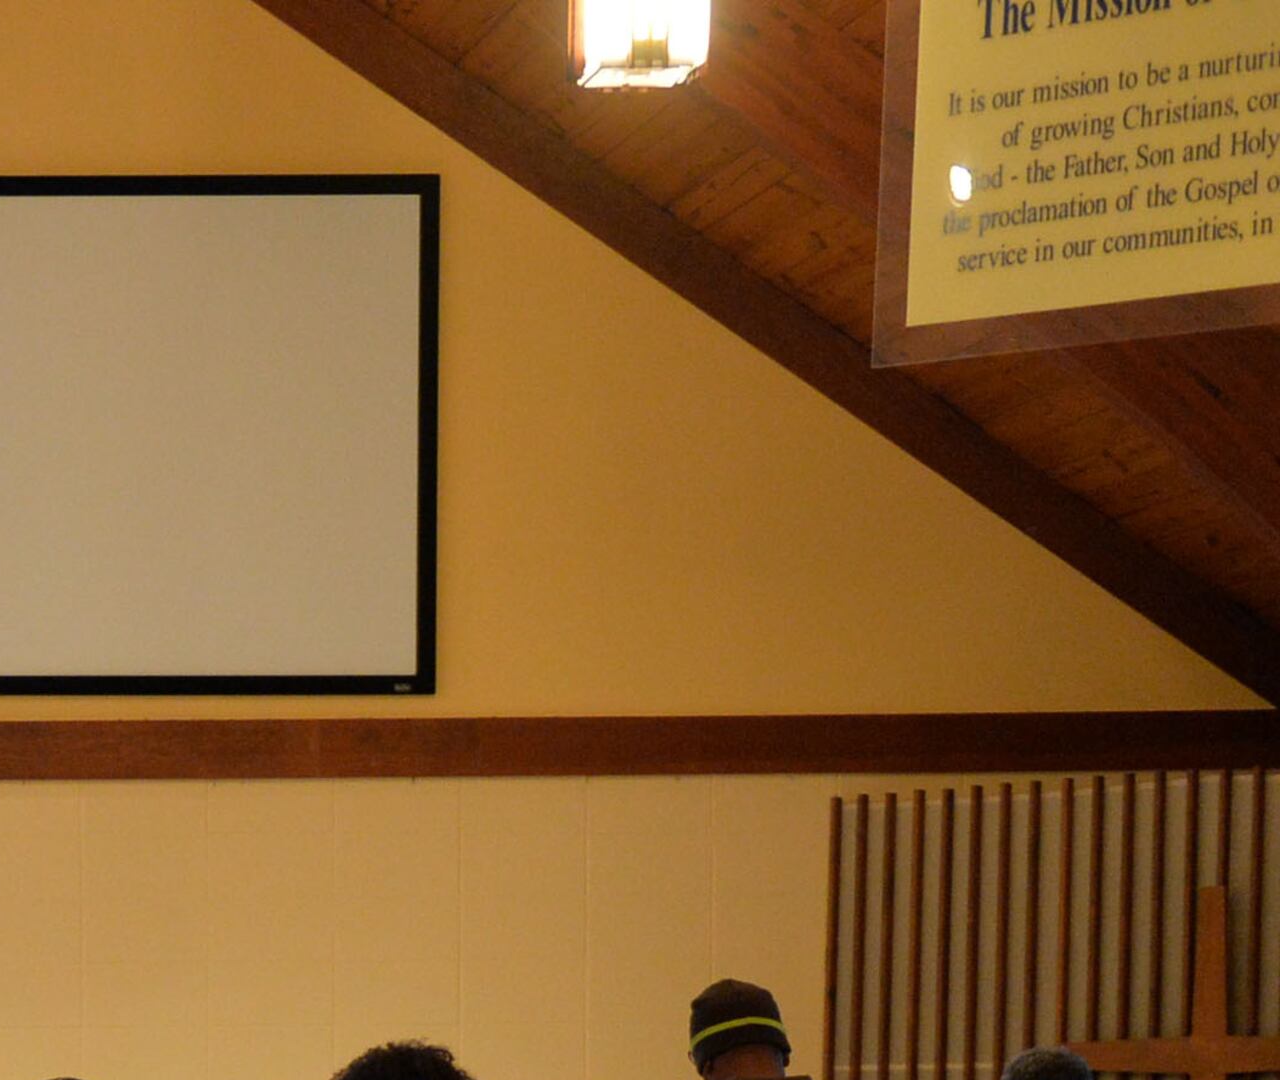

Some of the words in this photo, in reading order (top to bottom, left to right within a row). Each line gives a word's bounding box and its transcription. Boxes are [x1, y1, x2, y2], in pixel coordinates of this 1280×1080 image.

[977, 0, 1036, 39] The
[949, 92, 962, 117] It
[970, 89, 986, 113] is
[992, 87, 1025, 110] our
[1032, 71, 1109, 104] mission
[1119, 69, 1139, 91] to
[1147, 61, 1171, 87] be
[1178, 63, 1189, 83] a
[1199, 41, 1280, 79] nurturi
[1002, 121, 1025, 148] of
[1030, 113, 1115, 150] growing
[1123, 95, 1239, 131] Christians,
[1026, 159, 1056, 185] the
[1064, 150, 1129, 180] Father,
[1135, 143, 1175, 170] Son
[1182, 133, 1221, 163] and
[1231, 127, 1280, 160] Holy
[943, 209, 971, 235] the
[979, 192, 1107, 238] proclamation
[1116, 185, 1140, 213] of
[1146, 183, 1178, 209] the
[1185, 170, 1259, 205] Gospel
[958, 244, 1028, 273] service
[1035, 238, 1055, 263] in
[1062, 237, 1097, 260] our
[1103, 215, 1244, 254] communities,
[1252, 210, 1273, 236] in
